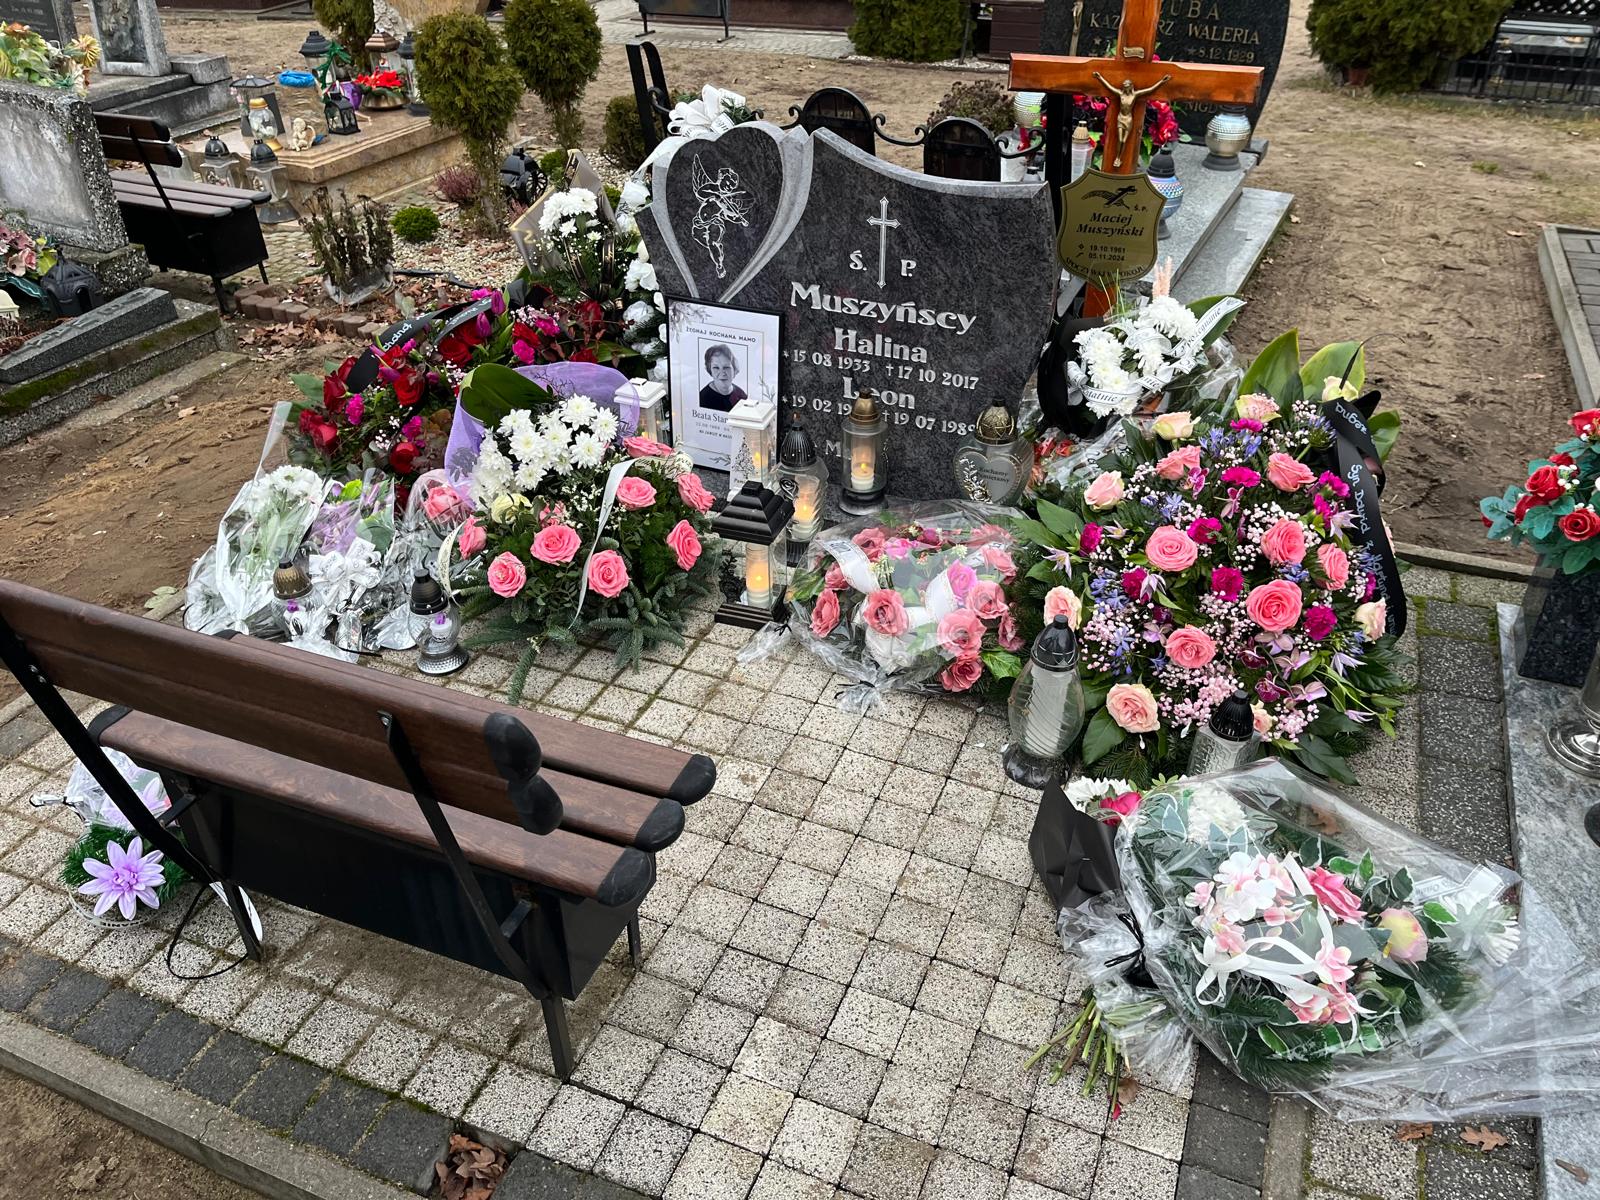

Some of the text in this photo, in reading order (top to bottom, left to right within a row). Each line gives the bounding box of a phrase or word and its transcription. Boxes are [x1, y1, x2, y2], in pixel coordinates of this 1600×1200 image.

[1160, 0, 1220, 20] UBA
[1188, 23, 1260, 45] WALERIA
[1186, 101, 1218, 113] NIGD
[1076, 223, 1145, 238] Muszyński
[1089, 212, 1133, 227] Maciej
[849, 249, 917, 277] Ś. P.
[1116, 264, 1145, 277] OKOJU
[790, 281, 977, 335] Muszyńscy
[709, 330, 737, 340] KOCHANA
[738, 335, 757, 343] MAMO
[834, 327, 928, 364] Halina
[793, 349, 980, 390] 15 08 1933 17 10 2017
[692, 409, 729, 424] Beata Star
[792, 395, 807, 408] 19
[812, 398, 832, 413] 02
[838, 402, 852, 416] 19
[894, 412, 910, 425] 19
[915, 415, 936, 431] 07
[1347, 464, 1363, 487] Syn
[1354, 489, 1371, 535] Dawid
